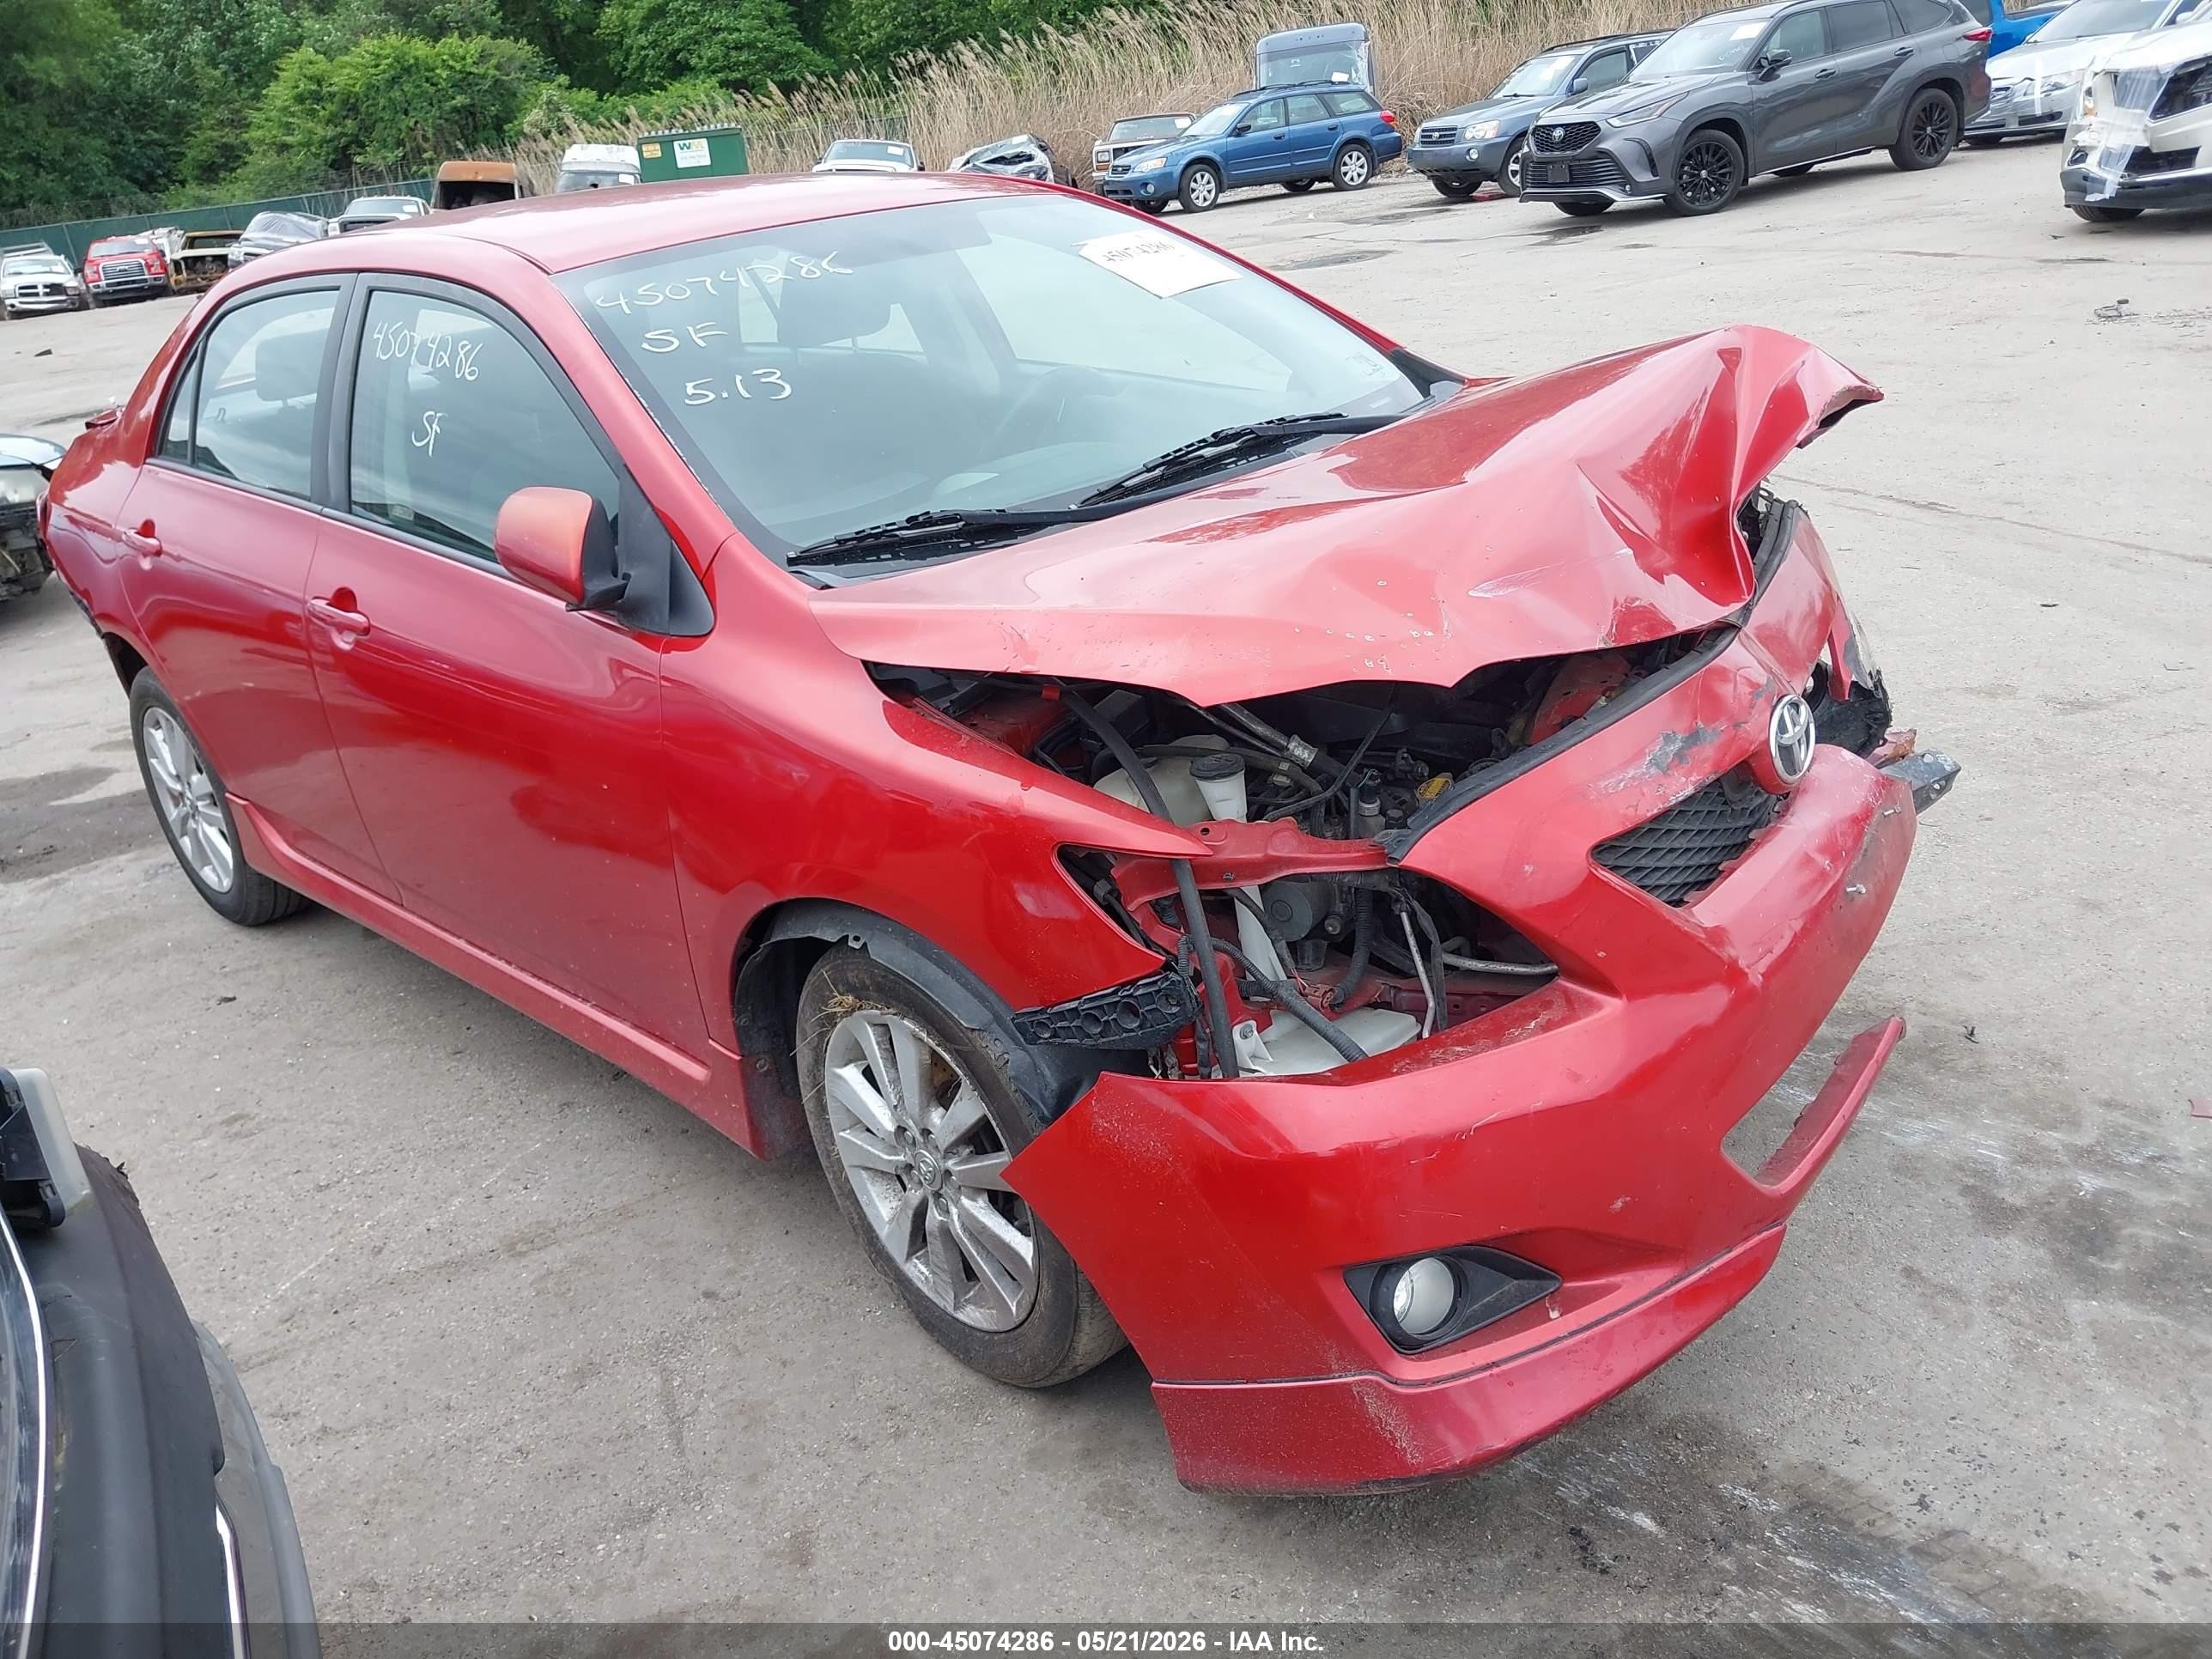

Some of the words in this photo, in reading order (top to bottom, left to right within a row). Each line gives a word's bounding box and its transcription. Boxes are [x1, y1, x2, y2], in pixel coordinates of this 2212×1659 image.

[596, 251, 854, 315] 45074286
[373, 321, 483, 381] 45074286
[641, 322, 729, 354] SF
[684, 368, 792, 405] 5.13
[411, 410, 449, 458] SF
